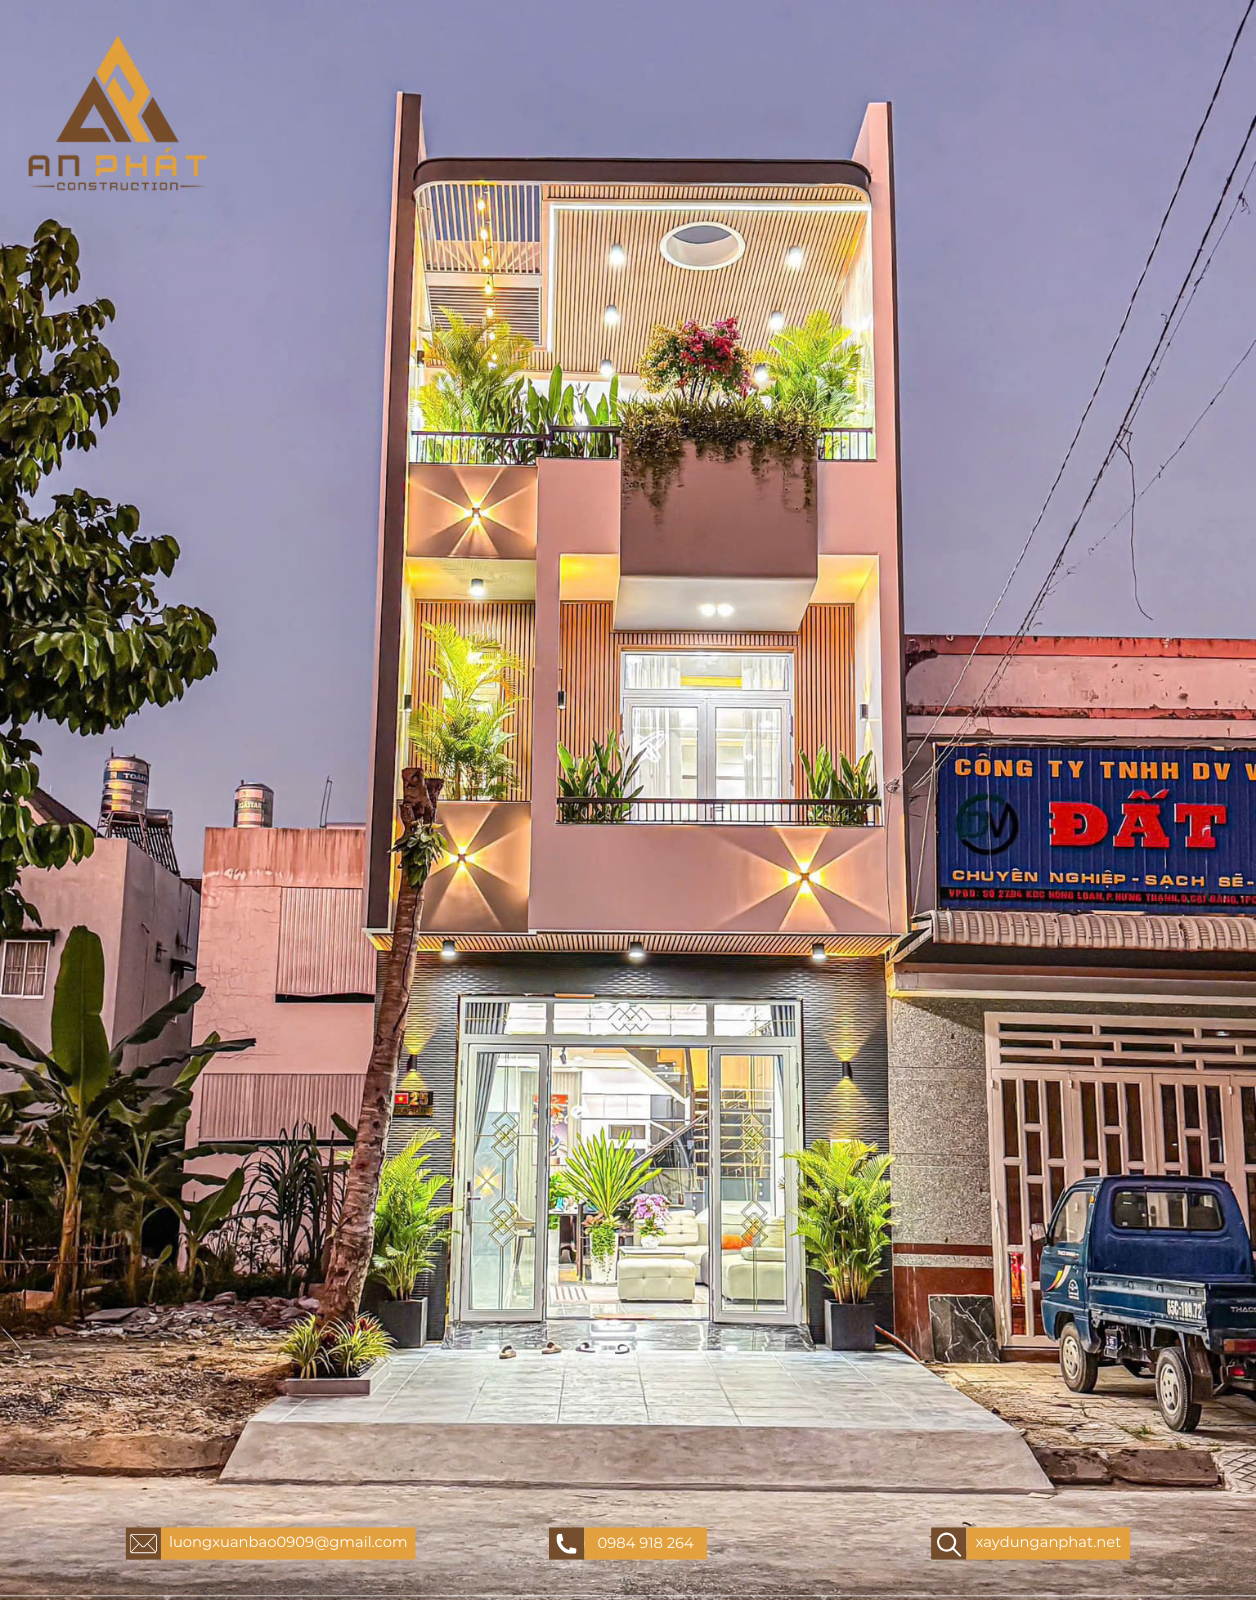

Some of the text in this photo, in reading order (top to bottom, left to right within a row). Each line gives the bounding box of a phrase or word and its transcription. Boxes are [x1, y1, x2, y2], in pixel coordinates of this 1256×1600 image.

[954, 753, 1033, 777] CÔNG
[1047, 760, 1084, 778] TY
[1099, 761, 1179, 779] TNHH
[1192, 763, 1231, 781] DV
[1048, 788, 1227, 849] ĐẤT
[952, 868, 1038, 882] CHUYÊN
[1049, 869, 1126, 888] NGHIỆP
[1145, 874, 1205, 889] SẠCH
